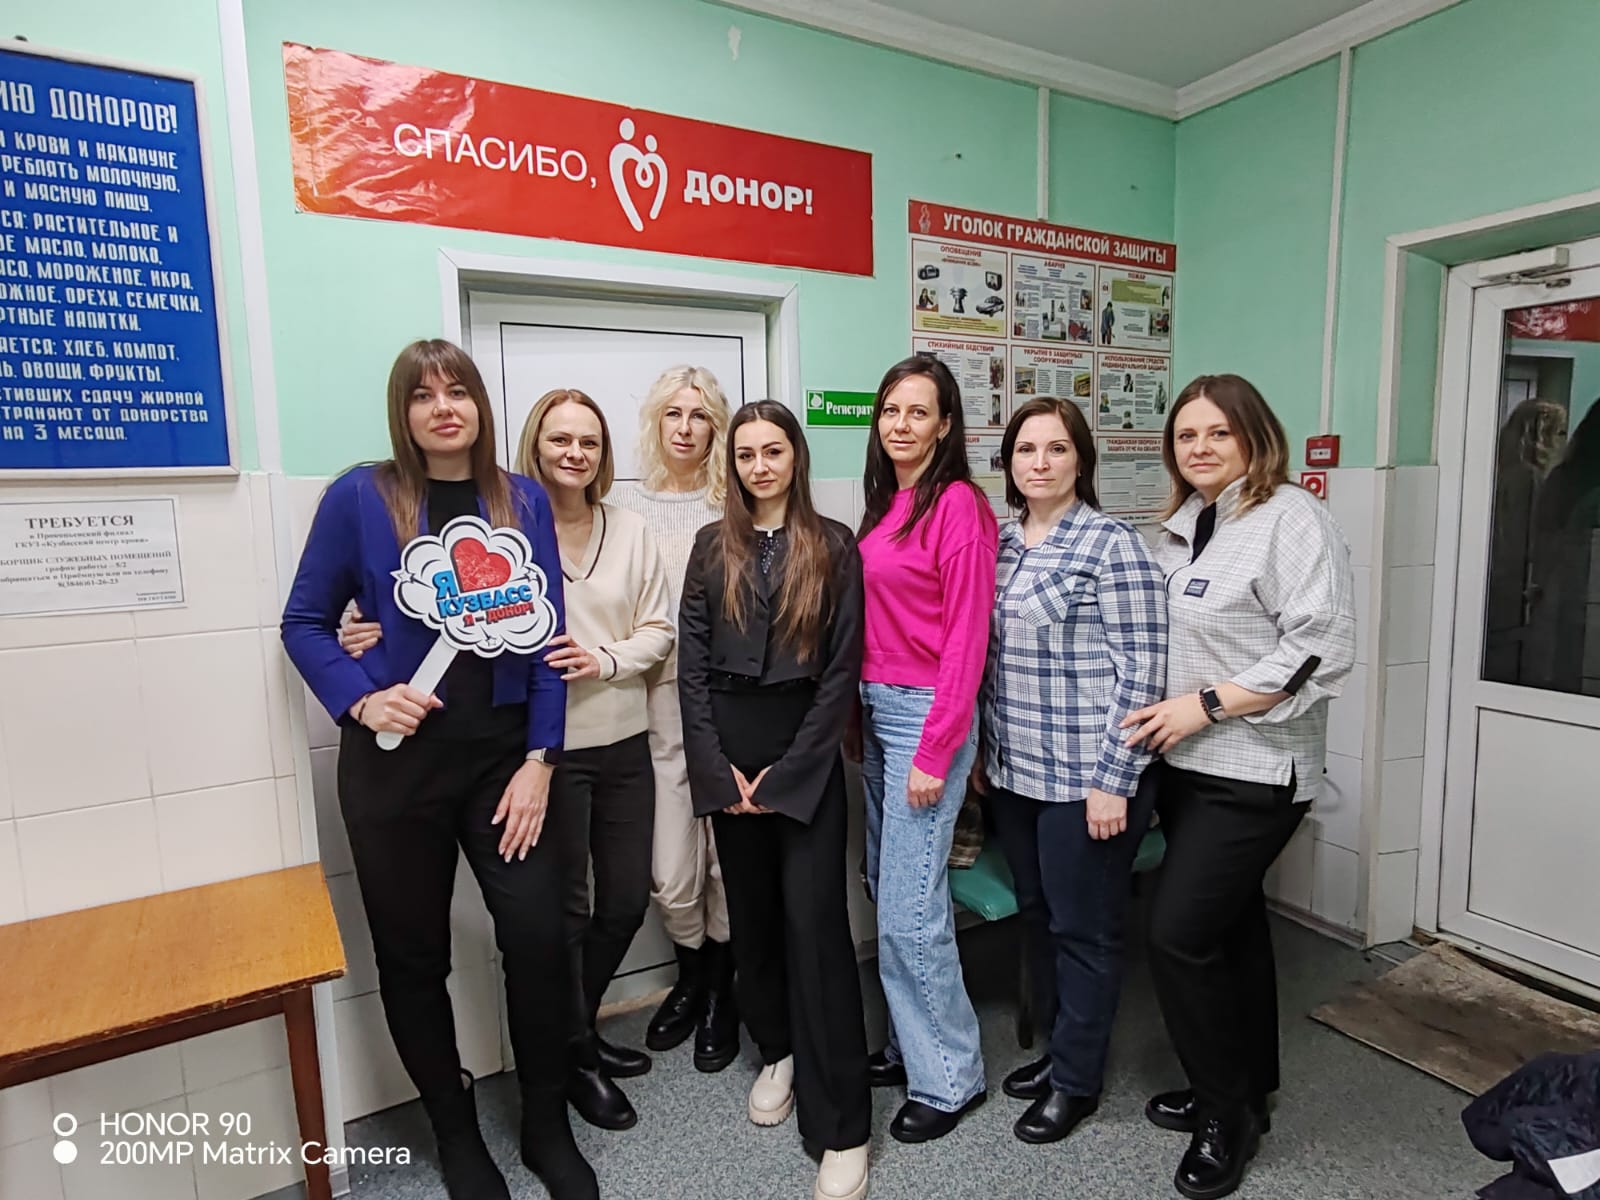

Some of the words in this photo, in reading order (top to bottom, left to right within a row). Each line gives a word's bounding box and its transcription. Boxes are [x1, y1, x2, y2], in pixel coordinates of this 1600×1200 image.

[49, 87, 178, 134] ДОНОРОВ!
[14, 131, 70, 156] КРОВИ
[78, 139, 88, 158] И
[96, 141, 178, 169] НАКАНУНЕ
[1, 154, 79, 180] РЕБЛЯТЬ
[86, 165, 180, 193] МОЛОЧНУЮ,
[393, 122, 598, 188] СПАСИБО,
[684, 169, 813, 215] ДОНОР!
[4, 179, 15, 198] И
[24, 182, 97, 206] МЯСНУЮ
[105, 190, 153, 213] ПИЩУ.
[1, 209, 28, 230] СЯ:
[33, 212, 161, 242] РАСТИТЕЛЬНОЕ
[168, 225, 179, 244] И
[943, 212, 1003, 239] УГОЛОК
[1007, 223, 1109, 256] ГРАЖДАНСКОЙ
[1113, 241, 1167, 265] ЗАЩИТЫ
[0, 387, 73, 403] ТИВШИХ
[81, 389, 133, 405] СДАЧУ
[141, 391, 204, 406] ЖИРНОЙ
[1, 406, 83, 421] ТРАНЯЮТ
[92, 408, 111, 422] ОТ
[120, 408, 209, 423] ДОНОРСТВА
[3, 426, 24, 441] НА
[34, 423, 48, 440] 3
[57, 426, 128, 441] МЕСЯЦА.
[25, 515, 134, 529] ТРЕБУЕТСЯ
[433, 570, 458, 600] Я
[437, 585, 532, 619] КУЗБАСС
[463, 614, 475, 627] Я
[486, 602, 535, 625] ДОНОР!
